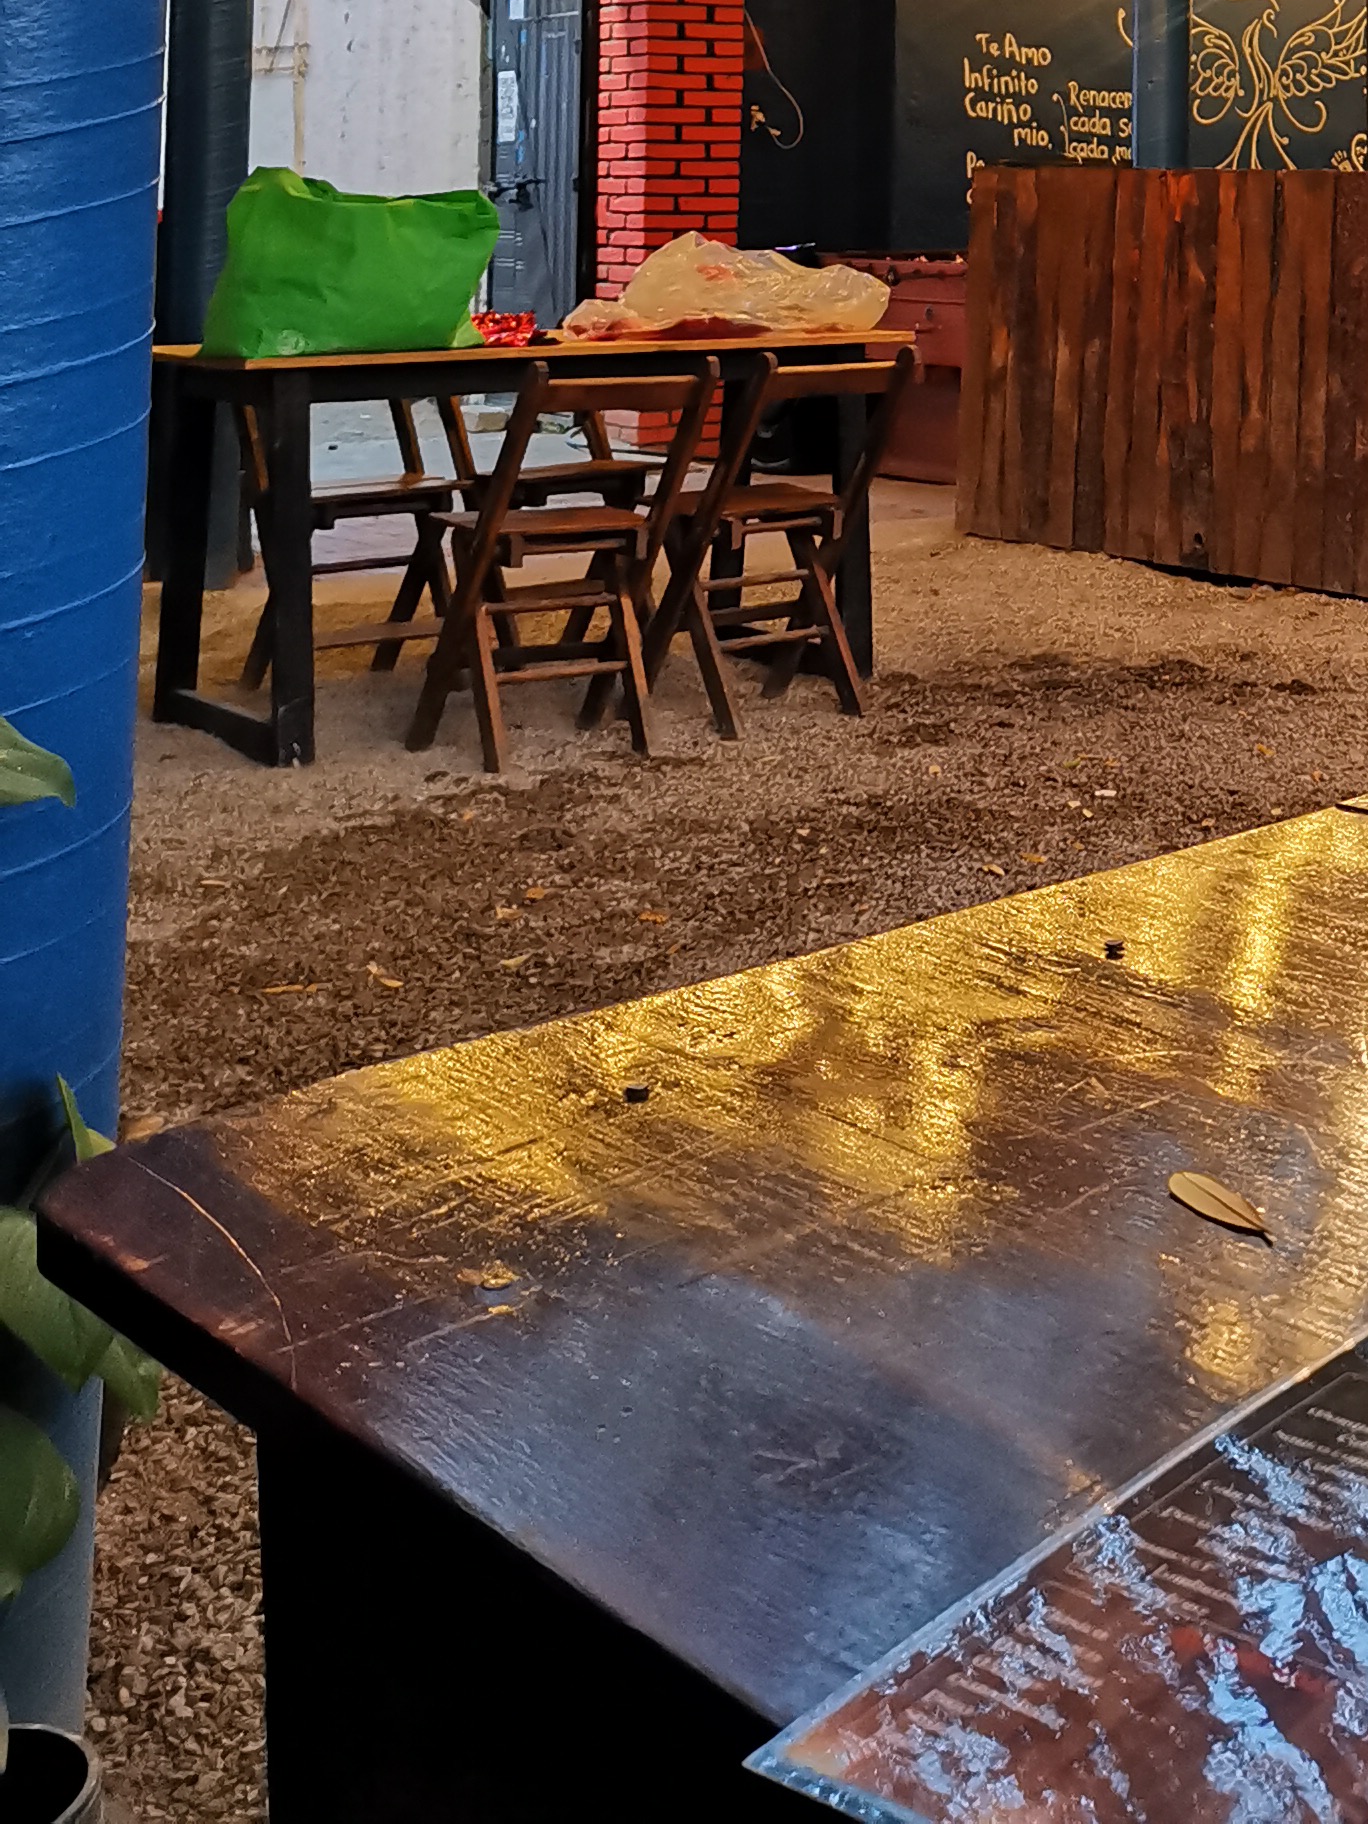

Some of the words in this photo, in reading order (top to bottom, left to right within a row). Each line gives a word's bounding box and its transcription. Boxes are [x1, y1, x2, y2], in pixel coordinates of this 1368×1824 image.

[975, 33, 1001, 57] Te
[1004, 32, 1052, 66] Amo
[963, 57, 1039, 96] Infinito
[964, 92, 1032, 125] Cariño
[1069, 109, 1112, 136] cada
[1069, 136, 1109, 160] cada
